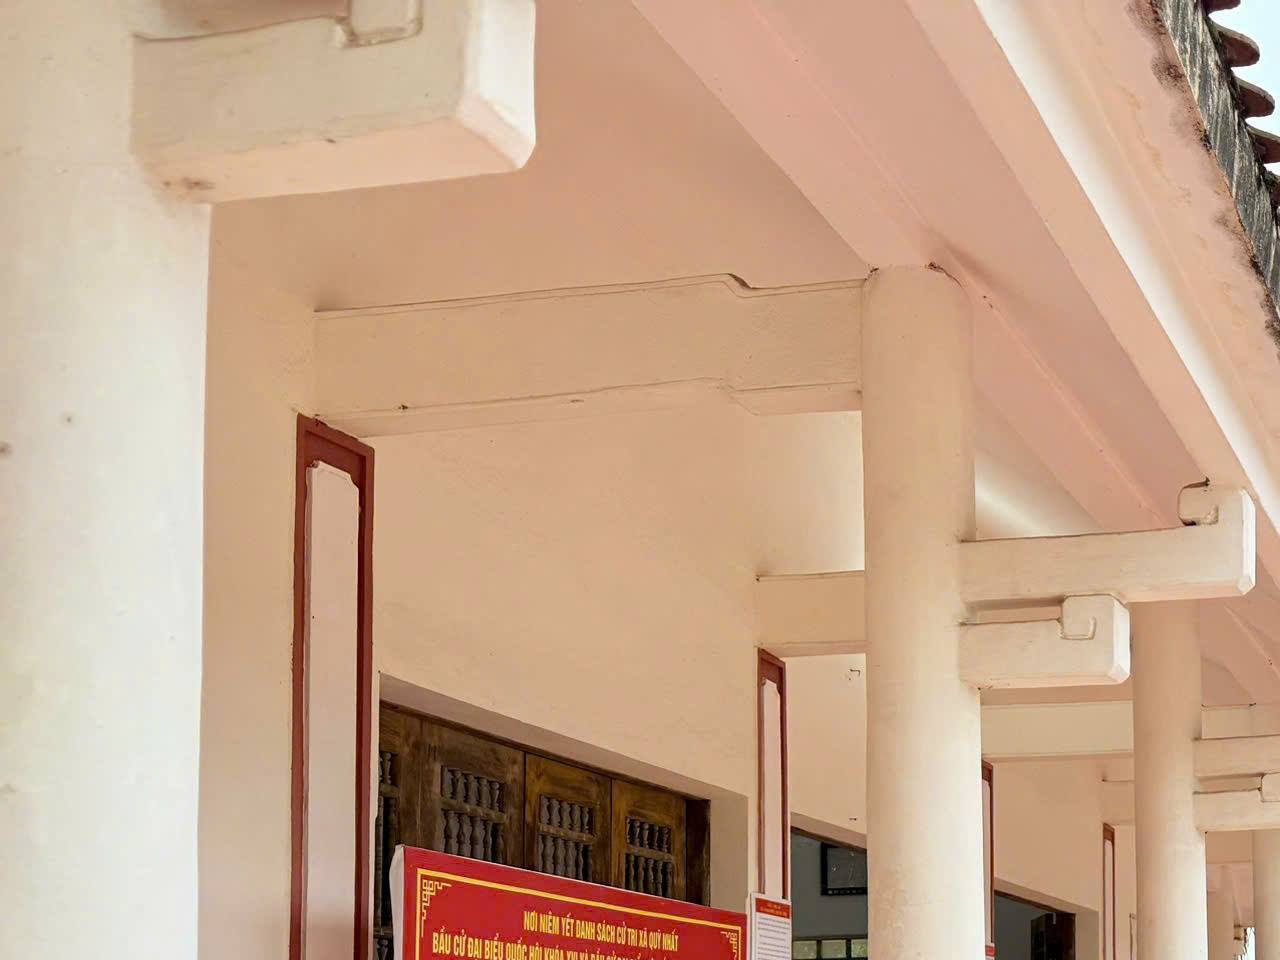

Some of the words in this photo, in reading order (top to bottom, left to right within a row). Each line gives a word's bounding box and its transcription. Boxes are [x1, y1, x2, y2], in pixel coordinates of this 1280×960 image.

[453, 929, 467, 956] CỬ
[484, 933, 504, 960] BIỂU
[524, 911, 538, 931] NƠI
[540, 911, 560, 935] NIÊM
[561, 913, 574, 937] YẾT
[576, 918, 596, 940] DANH
[597, 920, 615, 943] SÁCH
[617, 921, 627, 945] CỬ
[628, 929, 637, 947] TRI
[639, 927, 648, 948] XÃ
[663, 929, 679, 952] NHẤT
